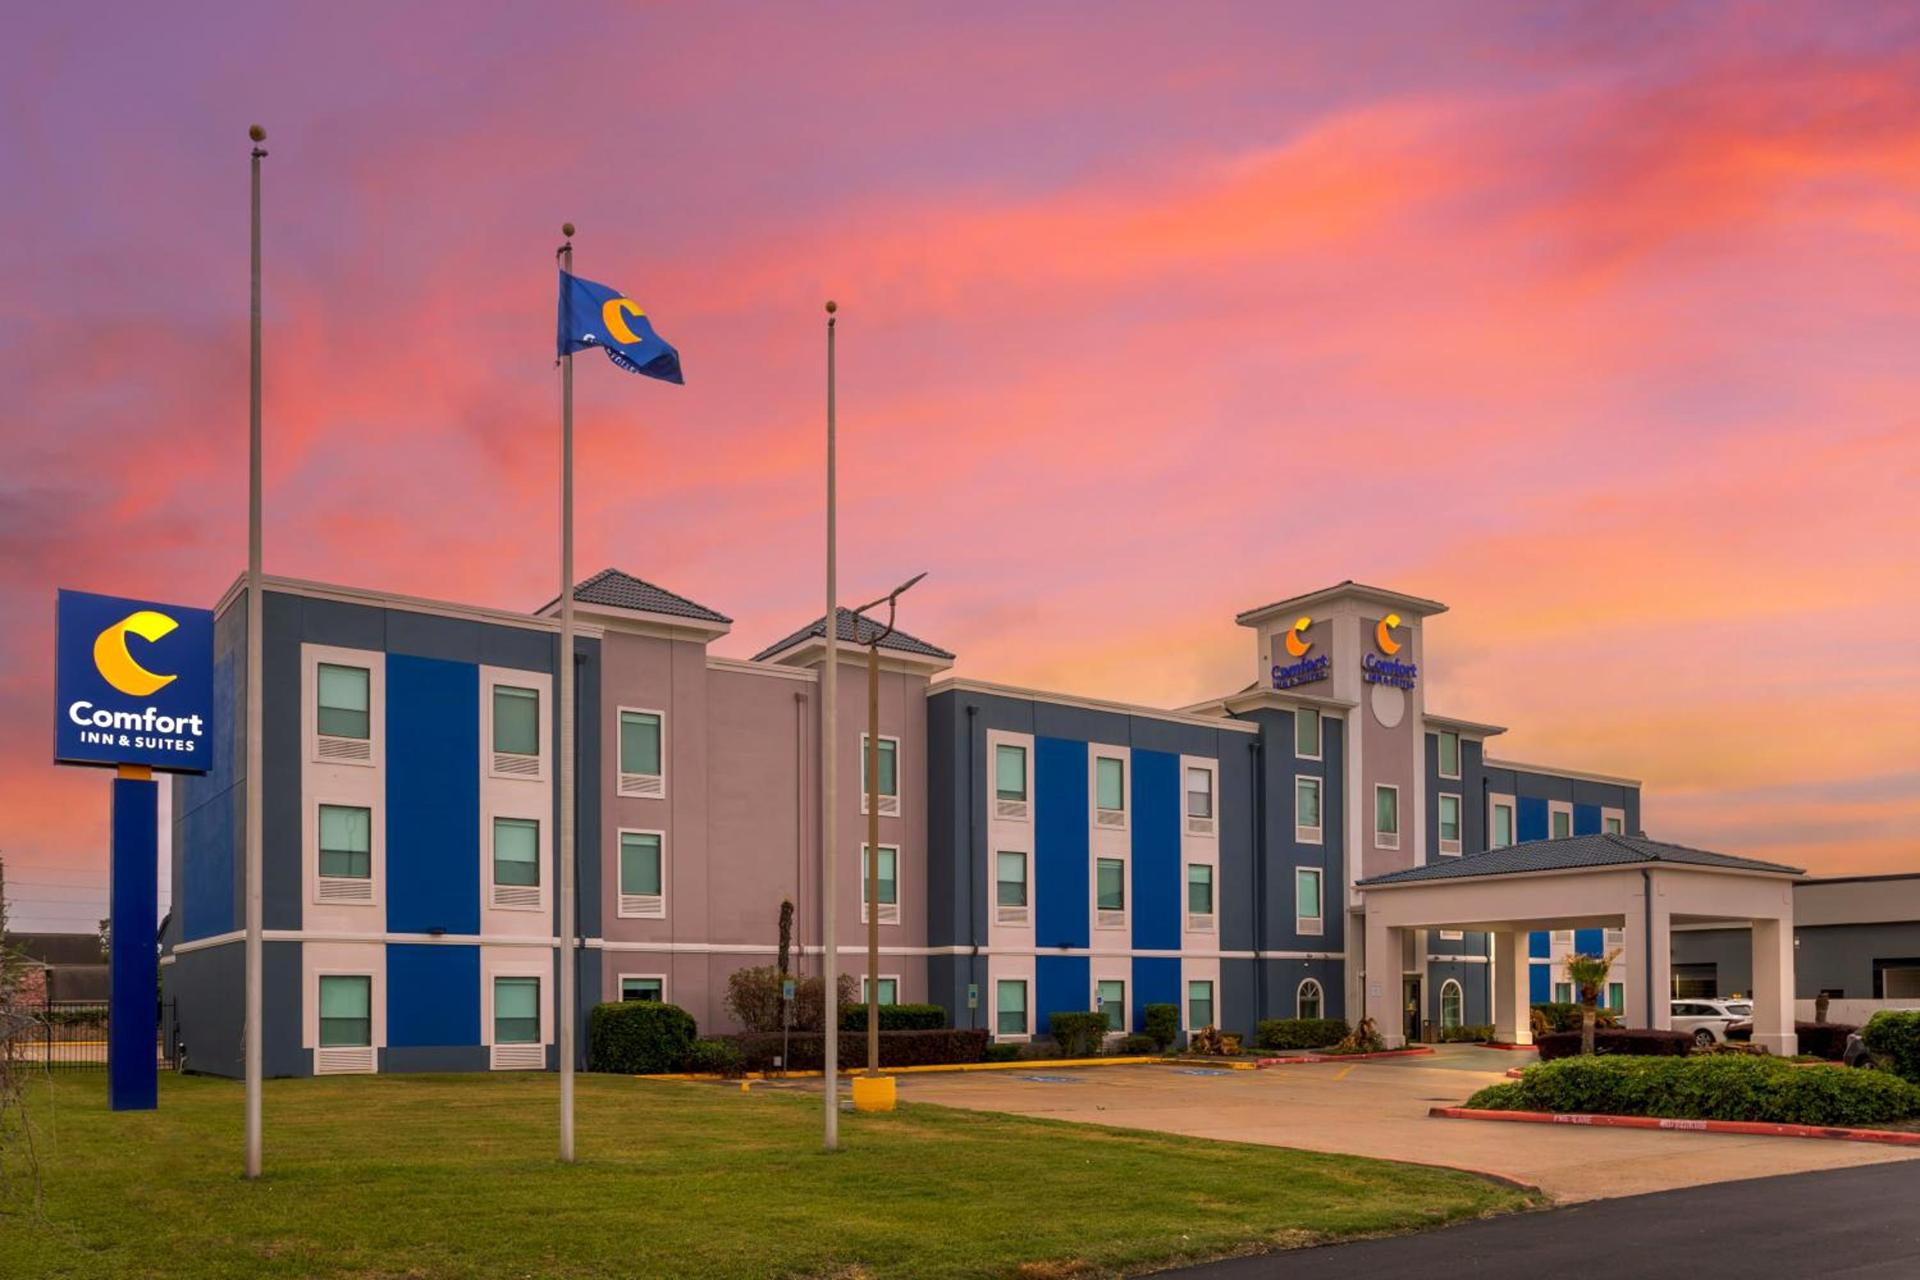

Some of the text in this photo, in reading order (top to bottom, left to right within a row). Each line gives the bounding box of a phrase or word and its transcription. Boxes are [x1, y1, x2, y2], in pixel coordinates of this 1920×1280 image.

[69, 700, 203, 736] Comfort
[80, 731, 195, 752] INN & SUITES
